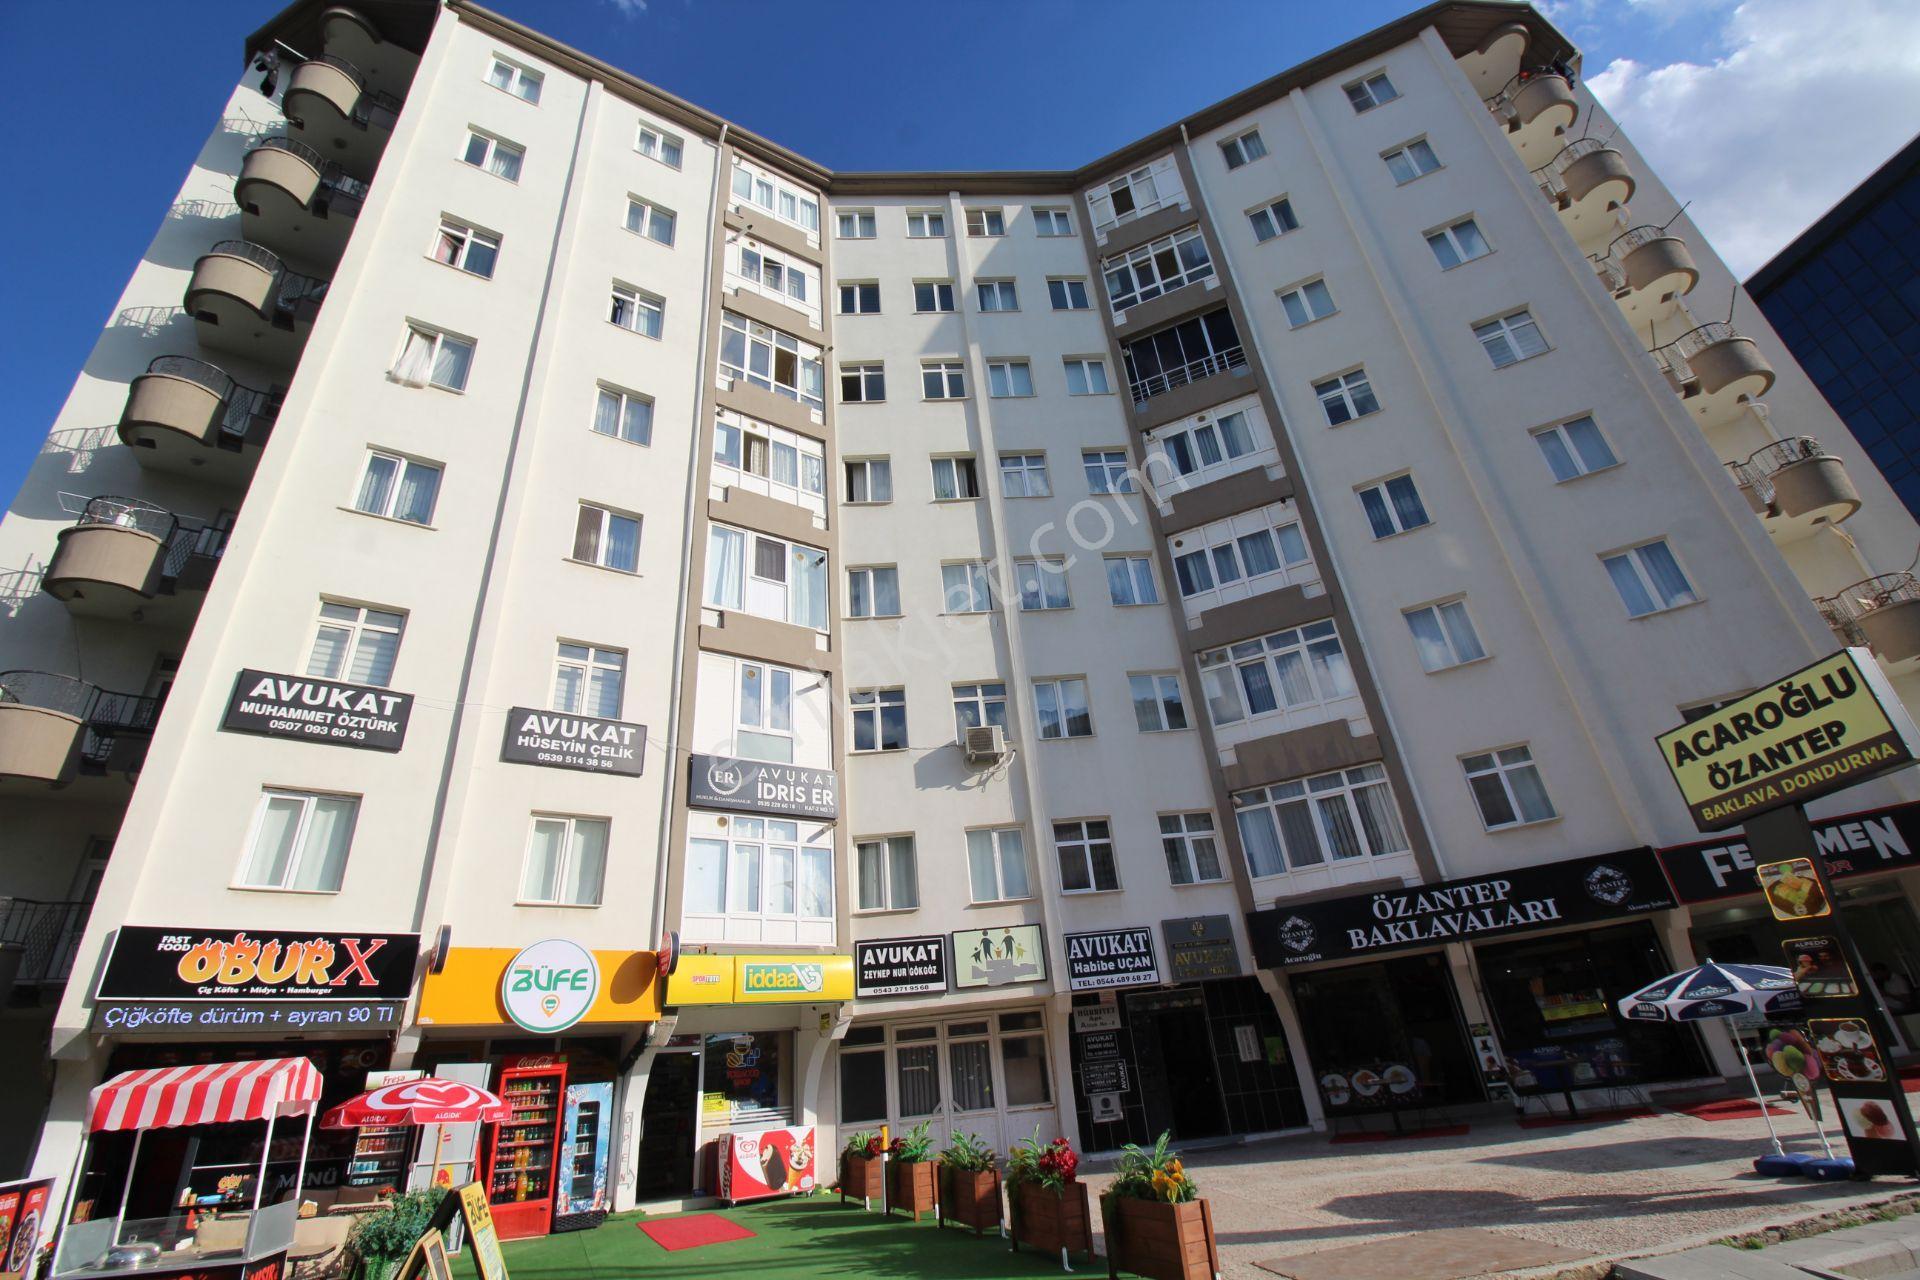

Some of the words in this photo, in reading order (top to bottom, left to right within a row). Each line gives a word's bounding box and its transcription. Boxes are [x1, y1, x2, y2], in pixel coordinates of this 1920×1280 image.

[249, 677, 402, 716] AVUKAT
[239, 701, 335, 724] MUHAMMET
[337, 712, 399, 733] ÖZTÜRK
[1675, 666, 1857, 768] ACAROĞLU
[269, 719, 303, 732] 0507
[305, 723, 328, 735] 093
[331, 727, 347, 738] 60
[349, 731, 366, 740] 43
[521, 714, 636, 745] AVUKAT
[517, 735, 588, 754] HÜSEYİN
[590, 744, 634, 760] ÇELİK
[1708, 720, 1847, 791] ÖZANTEP
[538, 752, 563, 762] 0539
[565, 756, 584, 765] 514
[586, 758, 598, 767] 38
[601, 760, 613, 768] 56
[714, 771, 734, 784] ER
[758, 767, 834, 787] AVUKAT
[1701, 785, 1779, 821] BAKLAVA
[1782, 742, 1898, 794] DONDURMA
[757, 778, 806, 803] İDRİS
[812, 788, 834, 806] ER
[1702, 817, 1911, 888] FEMEN
[1373, 879, 1511, 920] ÖZANTEP
[1347, 898, 1562, 950] BAKLAVALARI
[157, 943, 191, 952] FOOD
[161, 936, 192, 944] FAST
[1069, 932, 1148, 959] AVUKAT
[1794, 940, 1829, 949] ALPEDO
[863, 944, 939, 966] AVUKAT
[1074, 960, 1115, 974] Habibe
[1117, 956, 1151, 971] UÇAN
[512, 965, 588, 992] BÜFE
[749, 968, 798, 988] iddaa
[864, 969, 890, 980] ZEYNEP
[892, 969, 906, 978] NUR
[909, 965, 937, 976] GÖKGÖZ
[1078, 979, 1095, 987] TEL:
[214, 986, 239, 994] Köfte
[250, 986, 276, 995] Midye
[287, 986, 332, 995] Hamburger
[104, 1006, 193, 1028] Çiğköfte
[199, 1007, 263, 1024] dürüm
[270, 1010, 282, 1022] +
[288, 1010, 342, 1026] ayran
[347, 1007, 371, 1022] 90
[383, 1075, 405, 1084] Fresa
[280, 1167, 337, 1188] MNÜ
